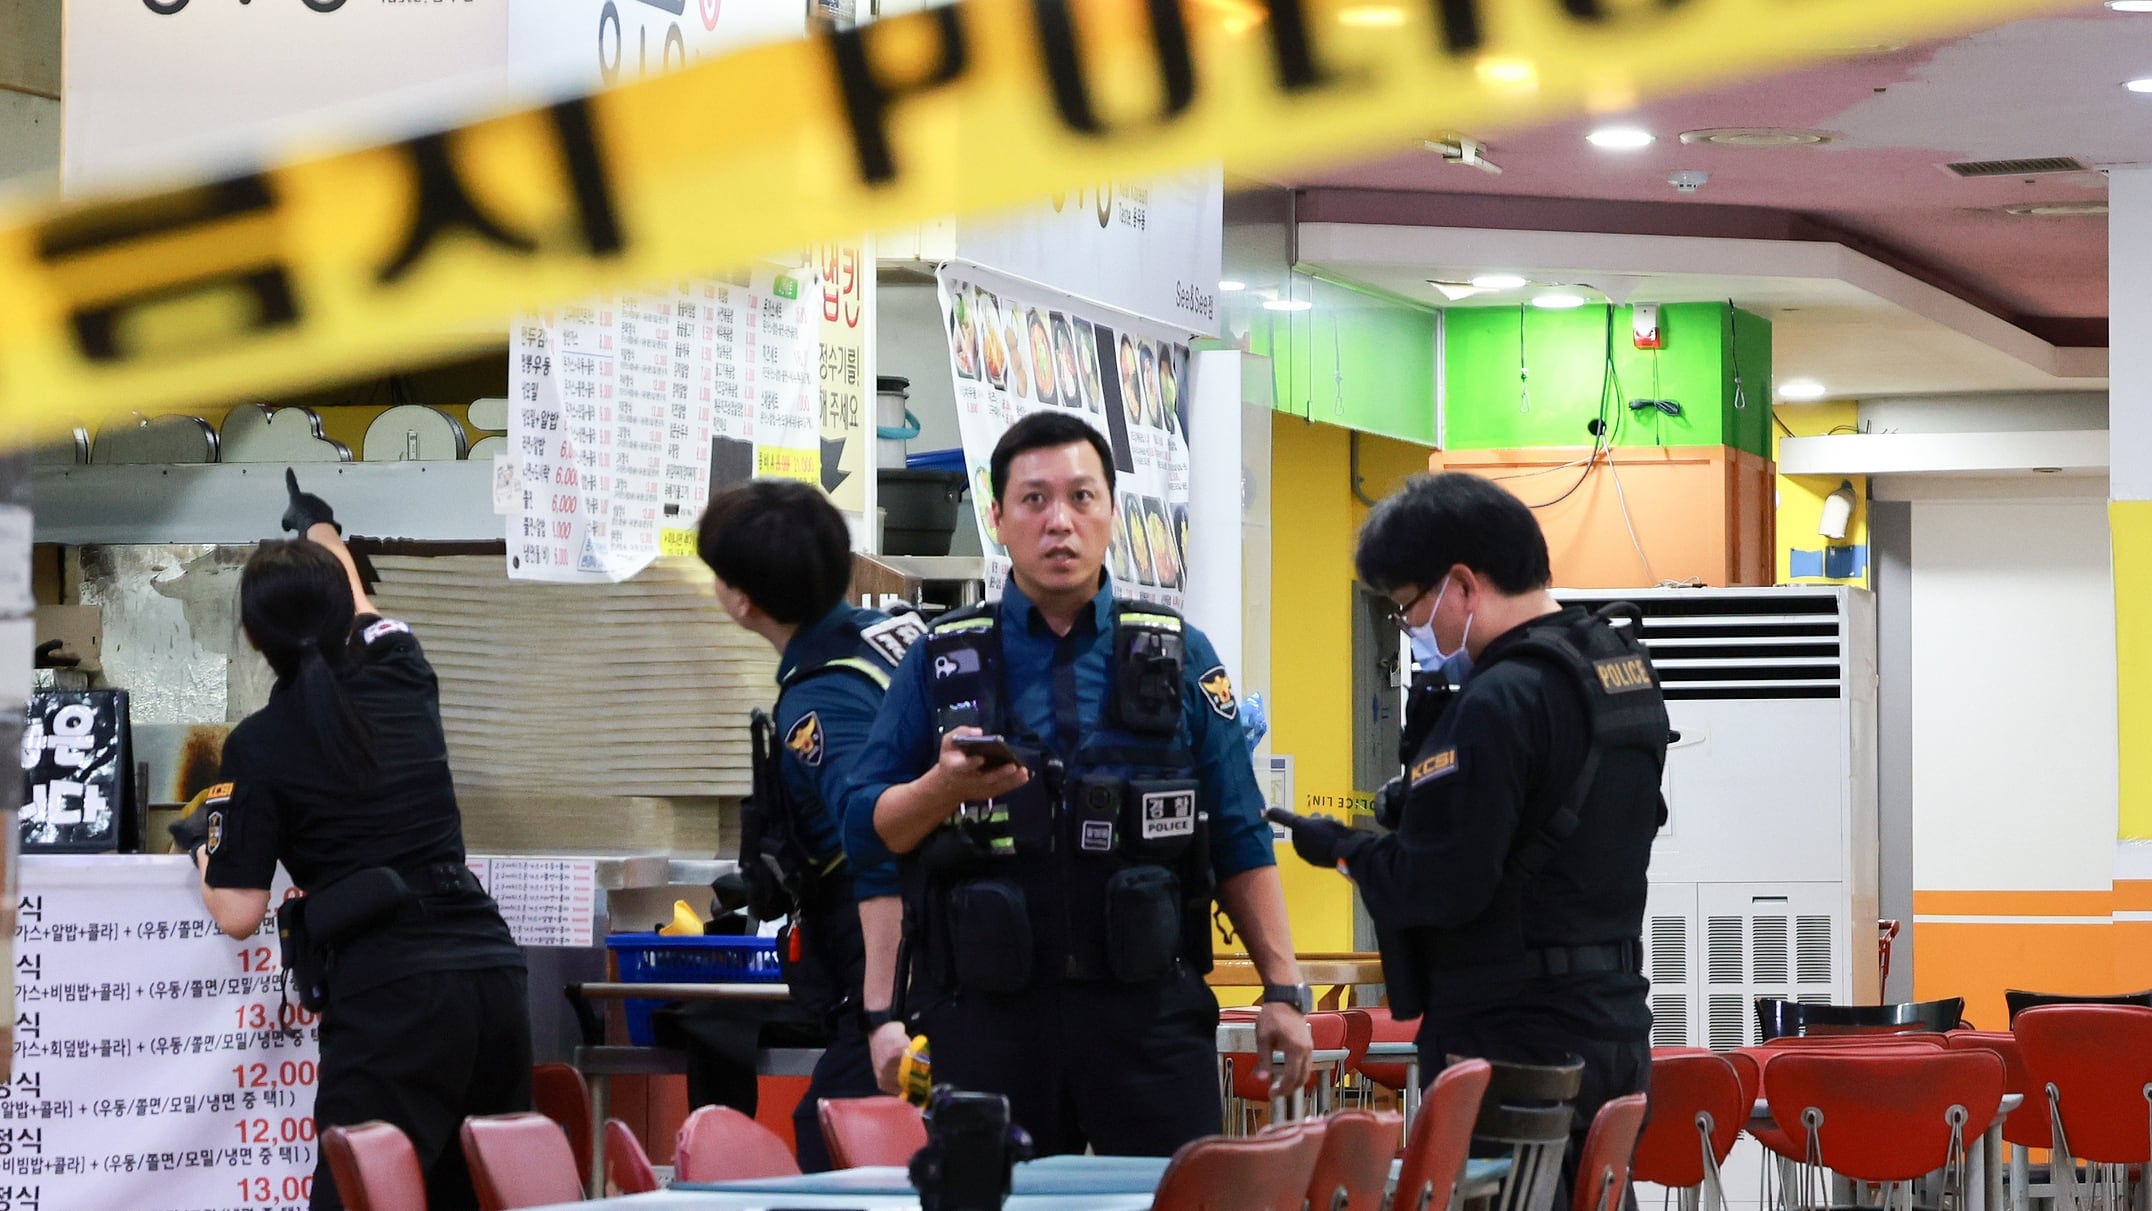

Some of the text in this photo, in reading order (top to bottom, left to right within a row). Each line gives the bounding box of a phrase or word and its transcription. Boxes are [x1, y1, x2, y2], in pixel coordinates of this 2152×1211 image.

[829, 391, 858, 430] 주세요
[1597, 658, 1651, 689] POLICE
[1411, 750, 1457, 781] KCSI
[1338, 797, 1375, 811] OLICE
[1148, 821, 1189, 833] POLICE
[18, 895, 42, 921] 식
[16, 954, 41, 980] 식
[16, 1012, 40, 1038] 식
[243, 1091, 256, 1109] 중
[259, 1147, 272, 1164] 중
